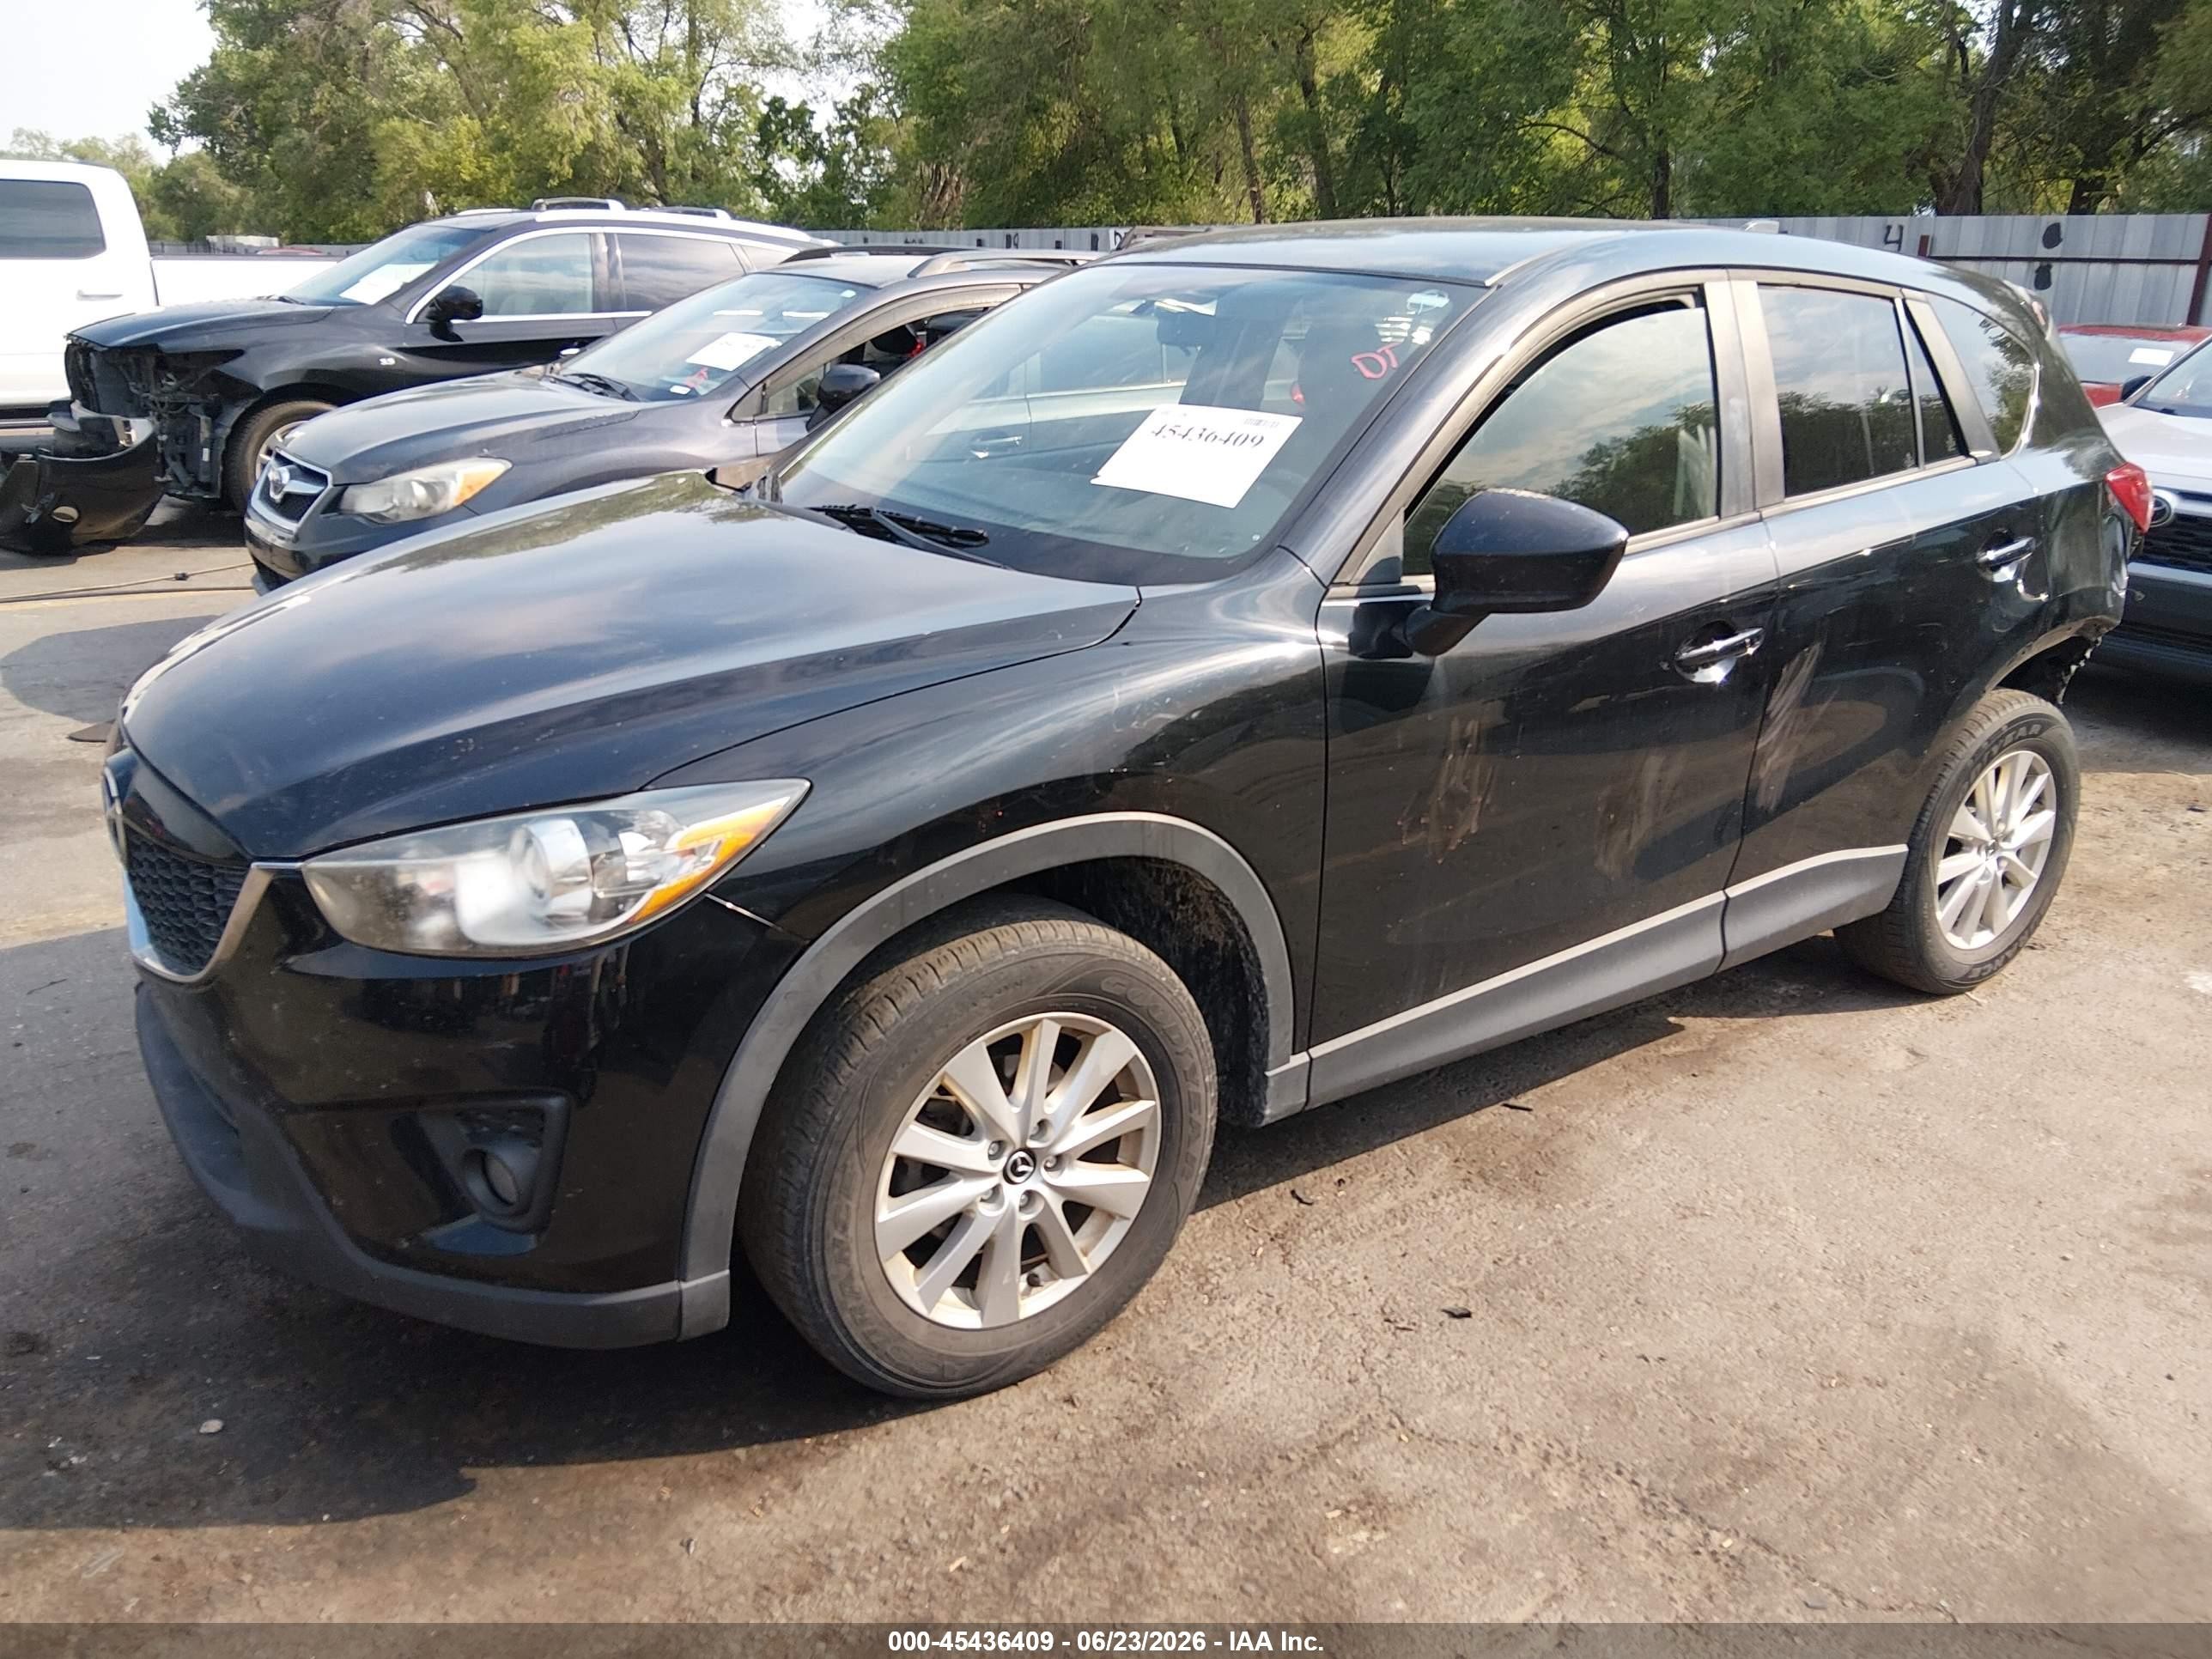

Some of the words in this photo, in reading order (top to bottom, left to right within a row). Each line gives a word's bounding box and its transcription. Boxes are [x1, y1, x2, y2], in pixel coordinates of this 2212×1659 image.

[1883, 224, 1904, 252] 4
[1351, 343, 1402, 380] DT
[1151, 424, 1265, 447] 45436409
[1100, 975, 1201, 1182] GOODYEAR
